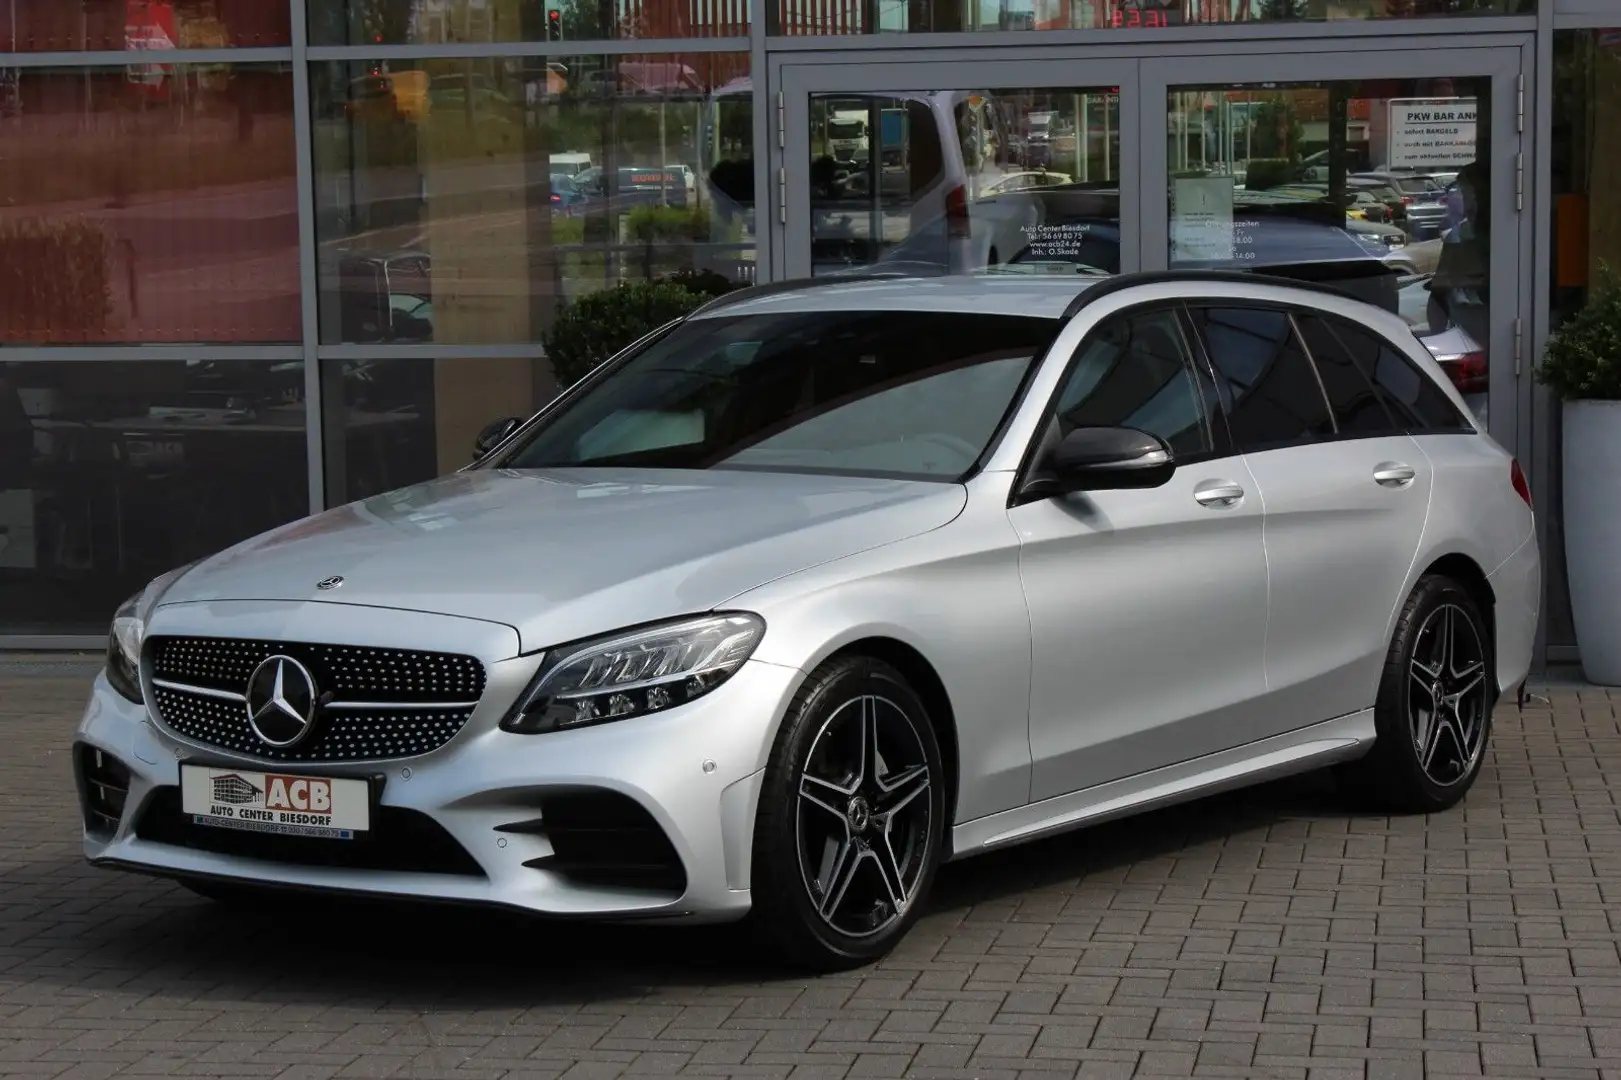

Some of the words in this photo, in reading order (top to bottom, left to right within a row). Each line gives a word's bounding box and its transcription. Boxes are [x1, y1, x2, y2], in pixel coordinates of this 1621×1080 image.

[1407, 112, 1431, 121] PKW
[1433, 112, 1454, 120] BAR
[1061, 224, 1090, 232] Biesdorf
[1029, 240, 1081, 248] www.acb24.de
[266, 777, 331, 812] ACB
[210, 804, 234, 818] AUTO
[239, 808, 274, 822] CENTER
[279, 812, 332, 826] BIESDORF
